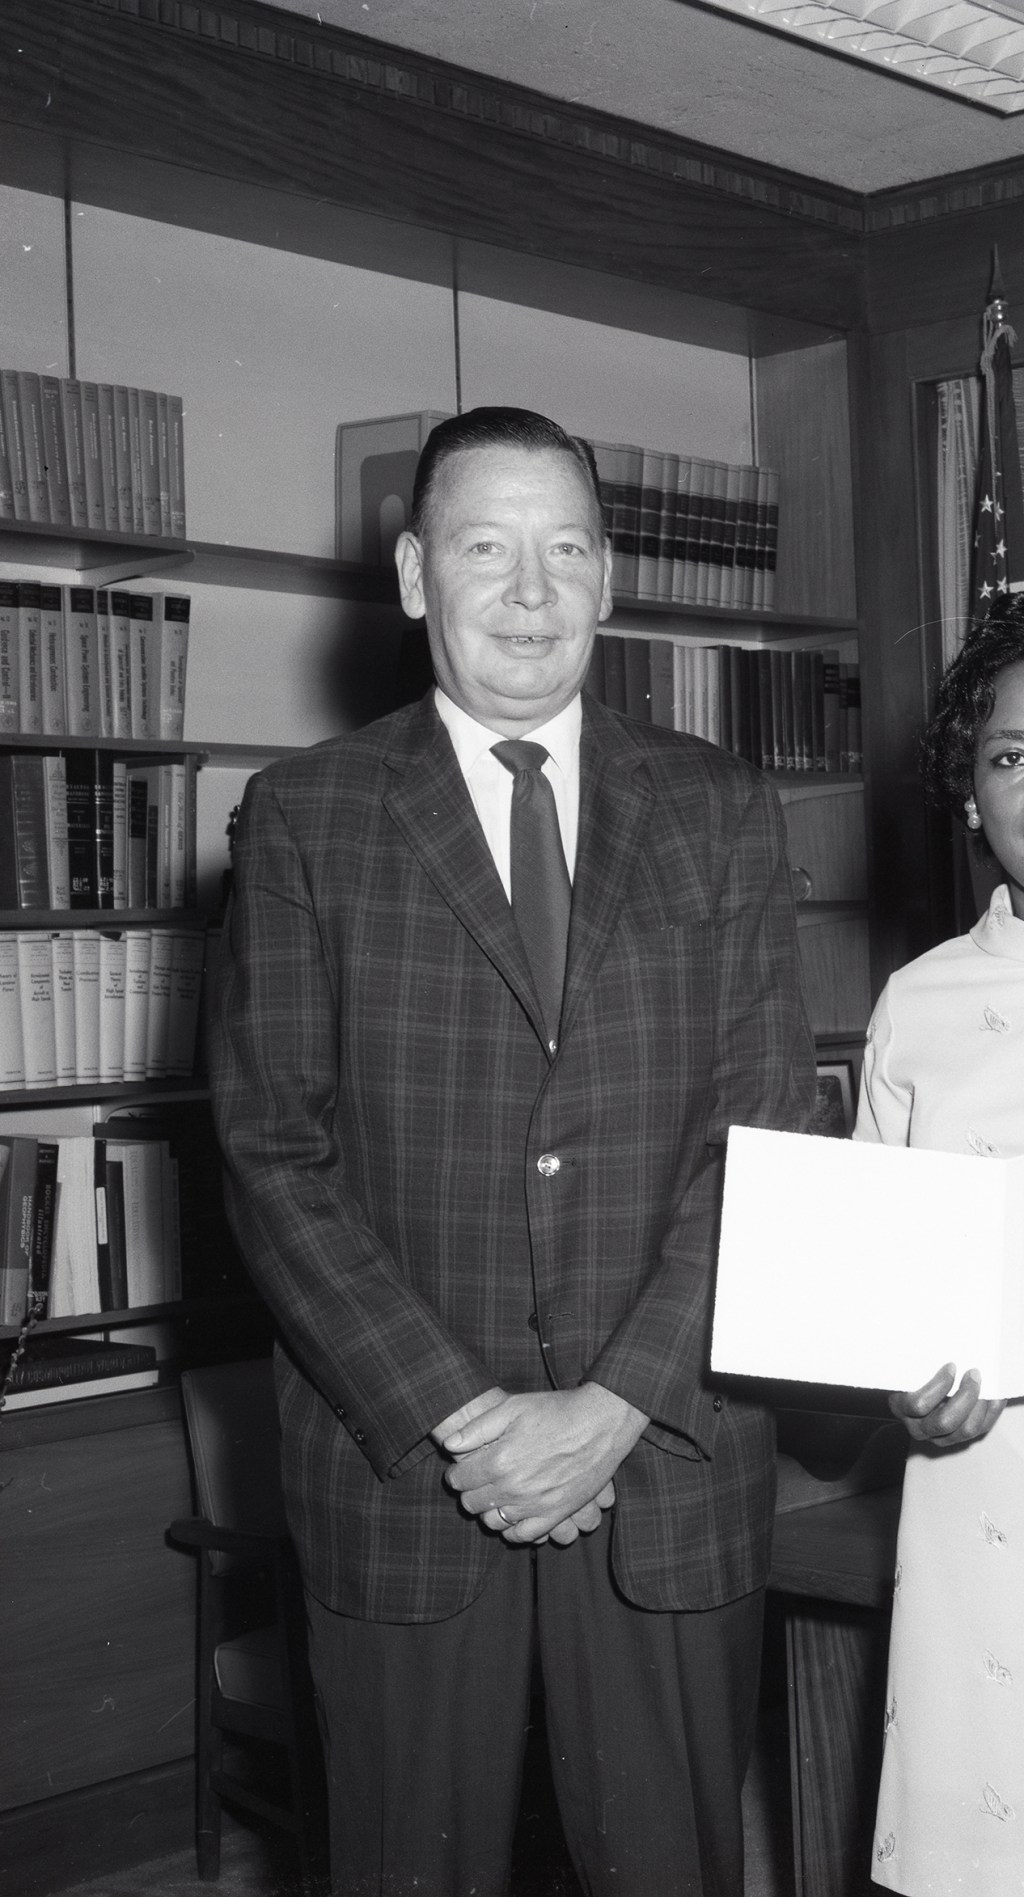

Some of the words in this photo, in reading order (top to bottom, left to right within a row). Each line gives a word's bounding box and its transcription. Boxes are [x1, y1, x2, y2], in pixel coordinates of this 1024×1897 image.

[80, 634, 89, 648] Space
[81, 649, 90, 663] Power
[81, 664, 91, 683] Systems
[81, 684, 91, 712] Engineering
[44, 1184, 52, 1215] ROCKET
[20, 1195, 28, 1248] GEOPHYSICS
[36, 1208, 44, 1255] Illustrated
[24, 1244, 30, 1256] OF
[41, 1219, 50, 1280] ENCYCLOPEDIA
